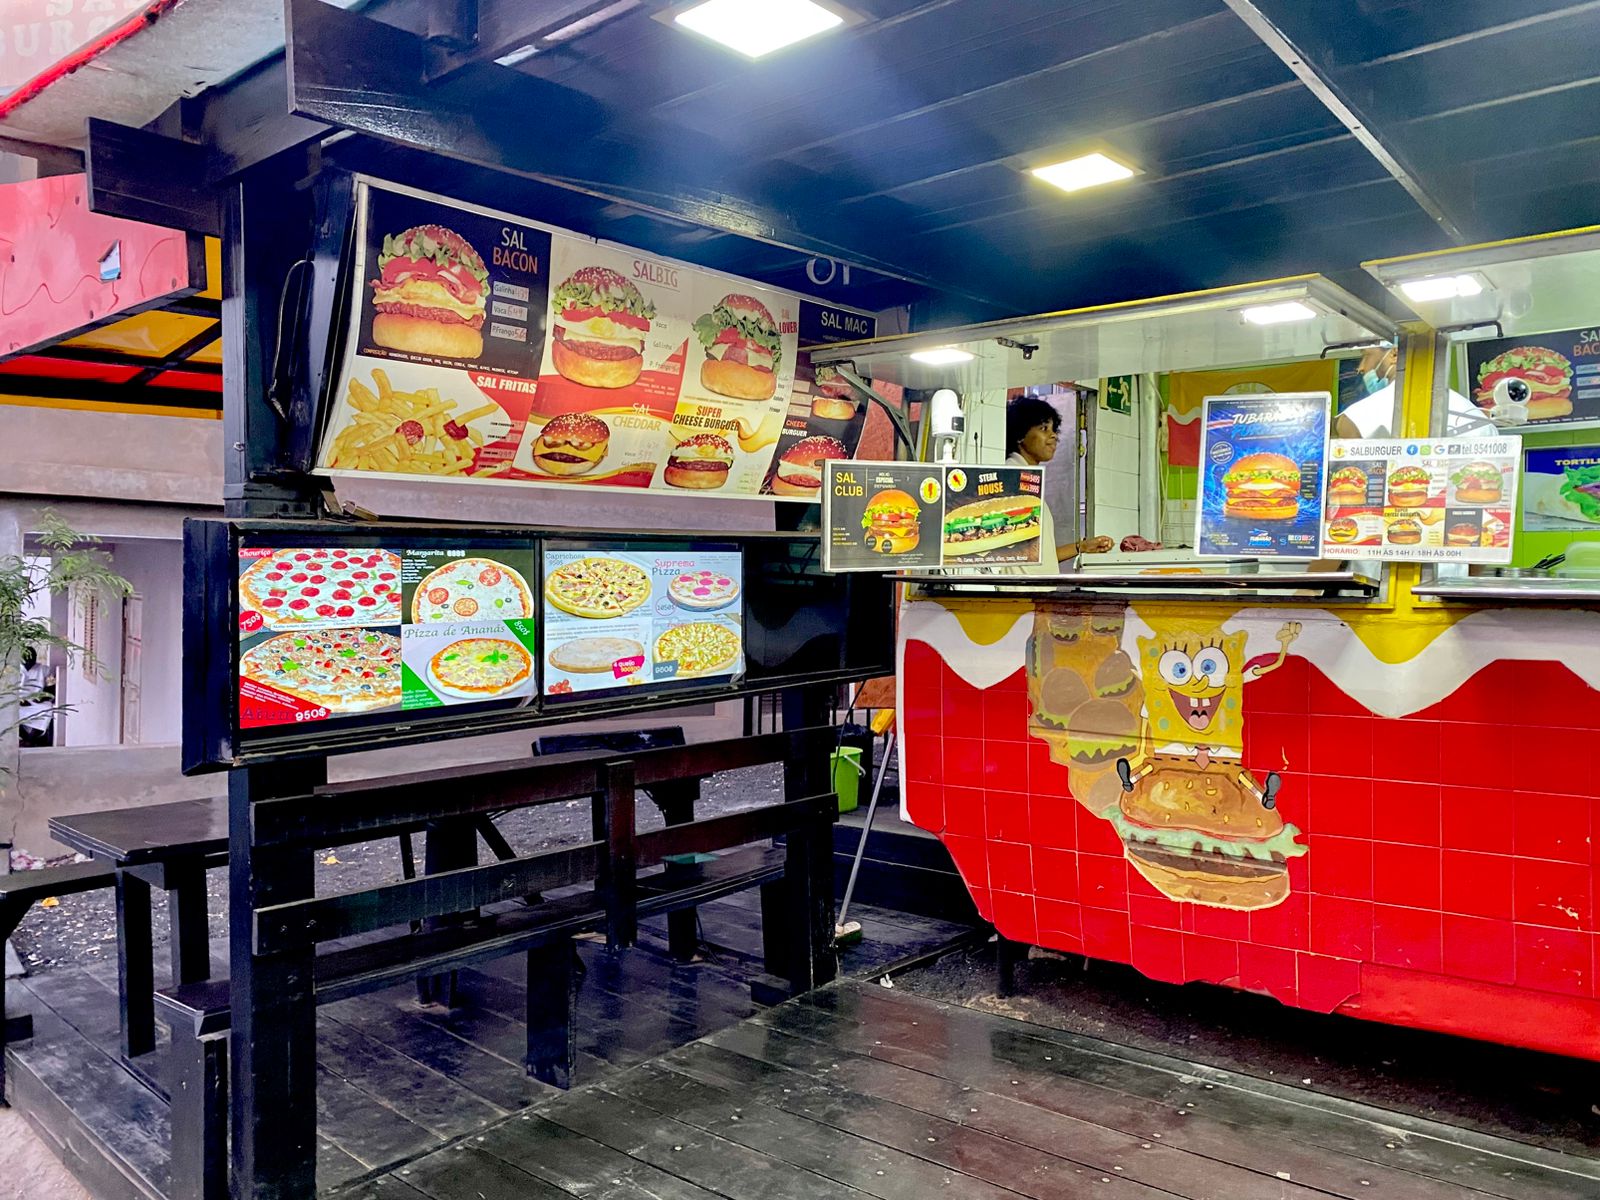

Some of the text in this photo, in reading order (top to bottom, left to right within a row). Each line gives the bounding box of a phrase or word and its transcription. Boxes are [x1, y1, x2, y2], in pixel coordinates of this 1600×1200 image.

[501, 227, 528, 251] SAL
[493, 246, 538, 274] BACON
[779, 321, 798, 334] LOVER
[821, 311, 868, 335] SAL MAC
[477, 375, 537, 395] SAL FRITAS
[631, 402, 651, 416] SAL
[696, 402, 723, 419] SUPER
[612, 415, 662, 431] CHEDDAR
[673, 411, 740, 431] CHEESE BURGUER
[785, 419, 808, 429] CHEESE
[781, 428, 808, 438] BURGUER
[1350, 446, 1403, 457] SALBURGUER
[836, 472, 857, 484] SAL
[978, 472, 998, 483] STEAK
[834, 485, 864, 497] CLUB
[977, 481, 1005, 496] HOUSE
[239, 548, 271, 557] Chouriço
[406, 549, 444, 558] Margarita
[655, 558, 696, 569] Suprema
[652, 567, 681, 576] Pizza
[404, 628, 439, 639] Pizza
[443, 624, 457, 637] de
[295, 707, 327, 722] 950$
